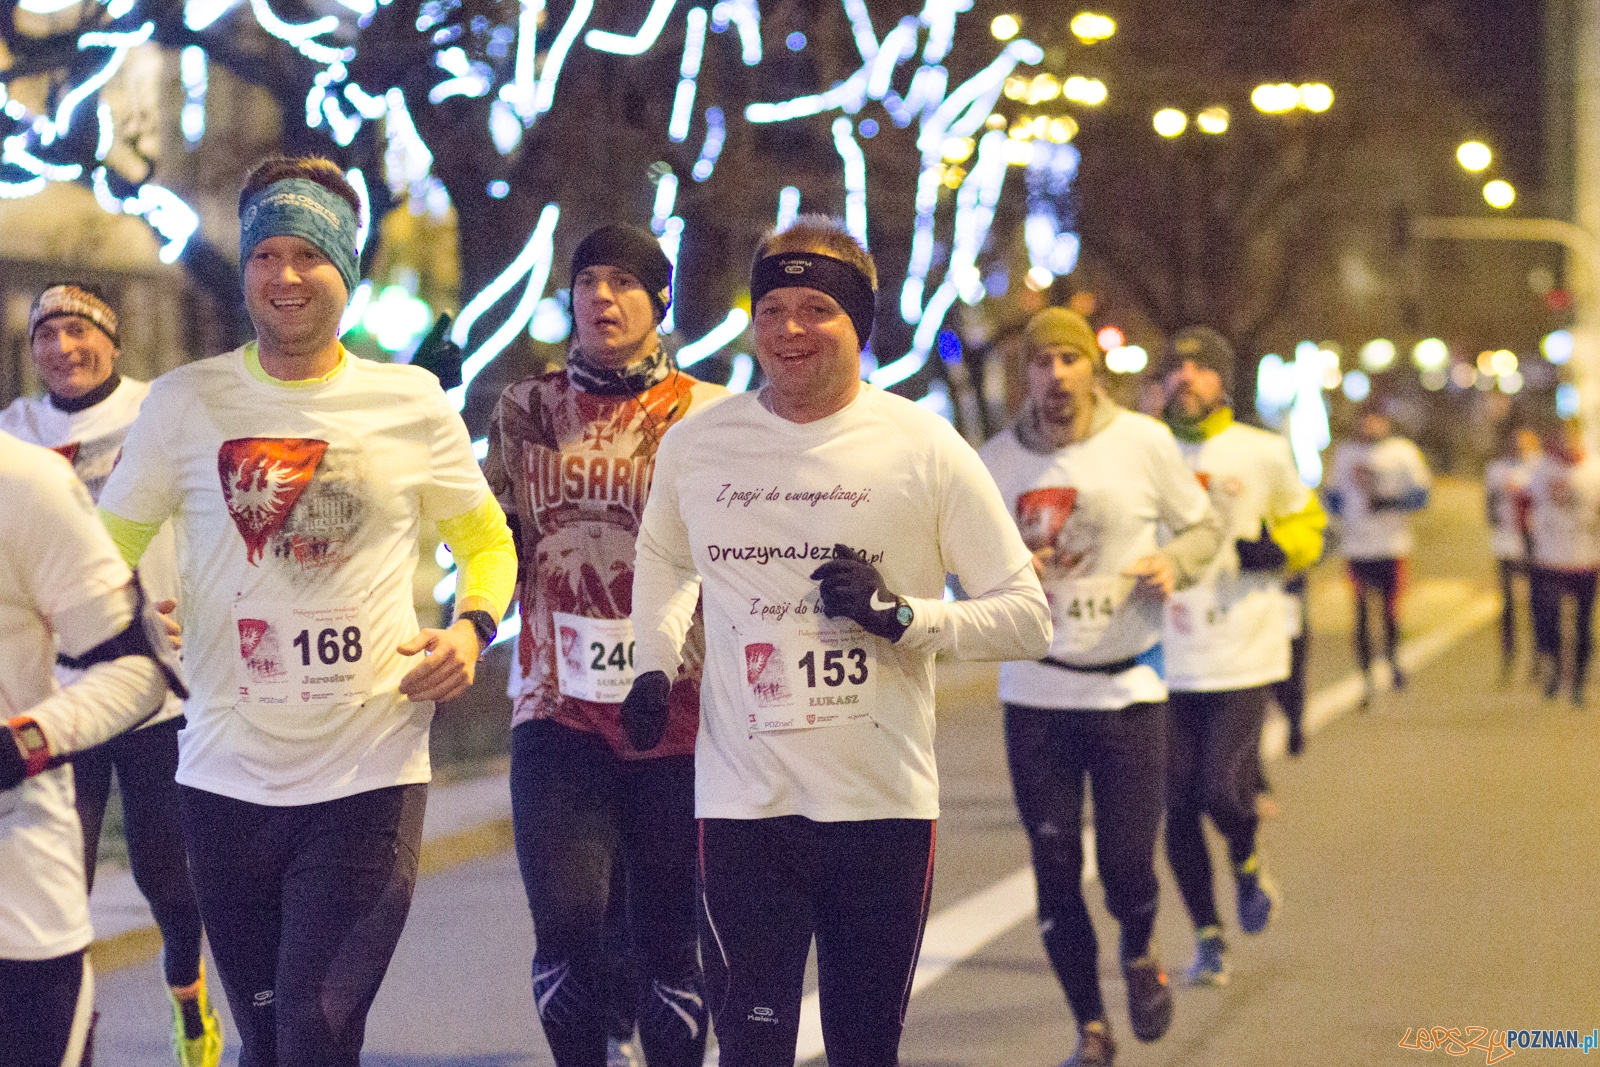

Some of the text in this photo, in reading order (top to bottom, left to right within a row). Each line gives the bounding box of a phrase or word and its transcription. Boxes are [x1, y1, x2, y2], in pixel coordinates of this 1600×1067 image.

[716, 483, 871, 508] Z pasji do ewangelizacji.
[761, 602, 791, 621] pasji
[794, 599, 808, 615] do
[293, 625, 363, 666] 168
[798, 647, 869, 688] 153
[809, 694, 860, 707] ŁUKASZ
